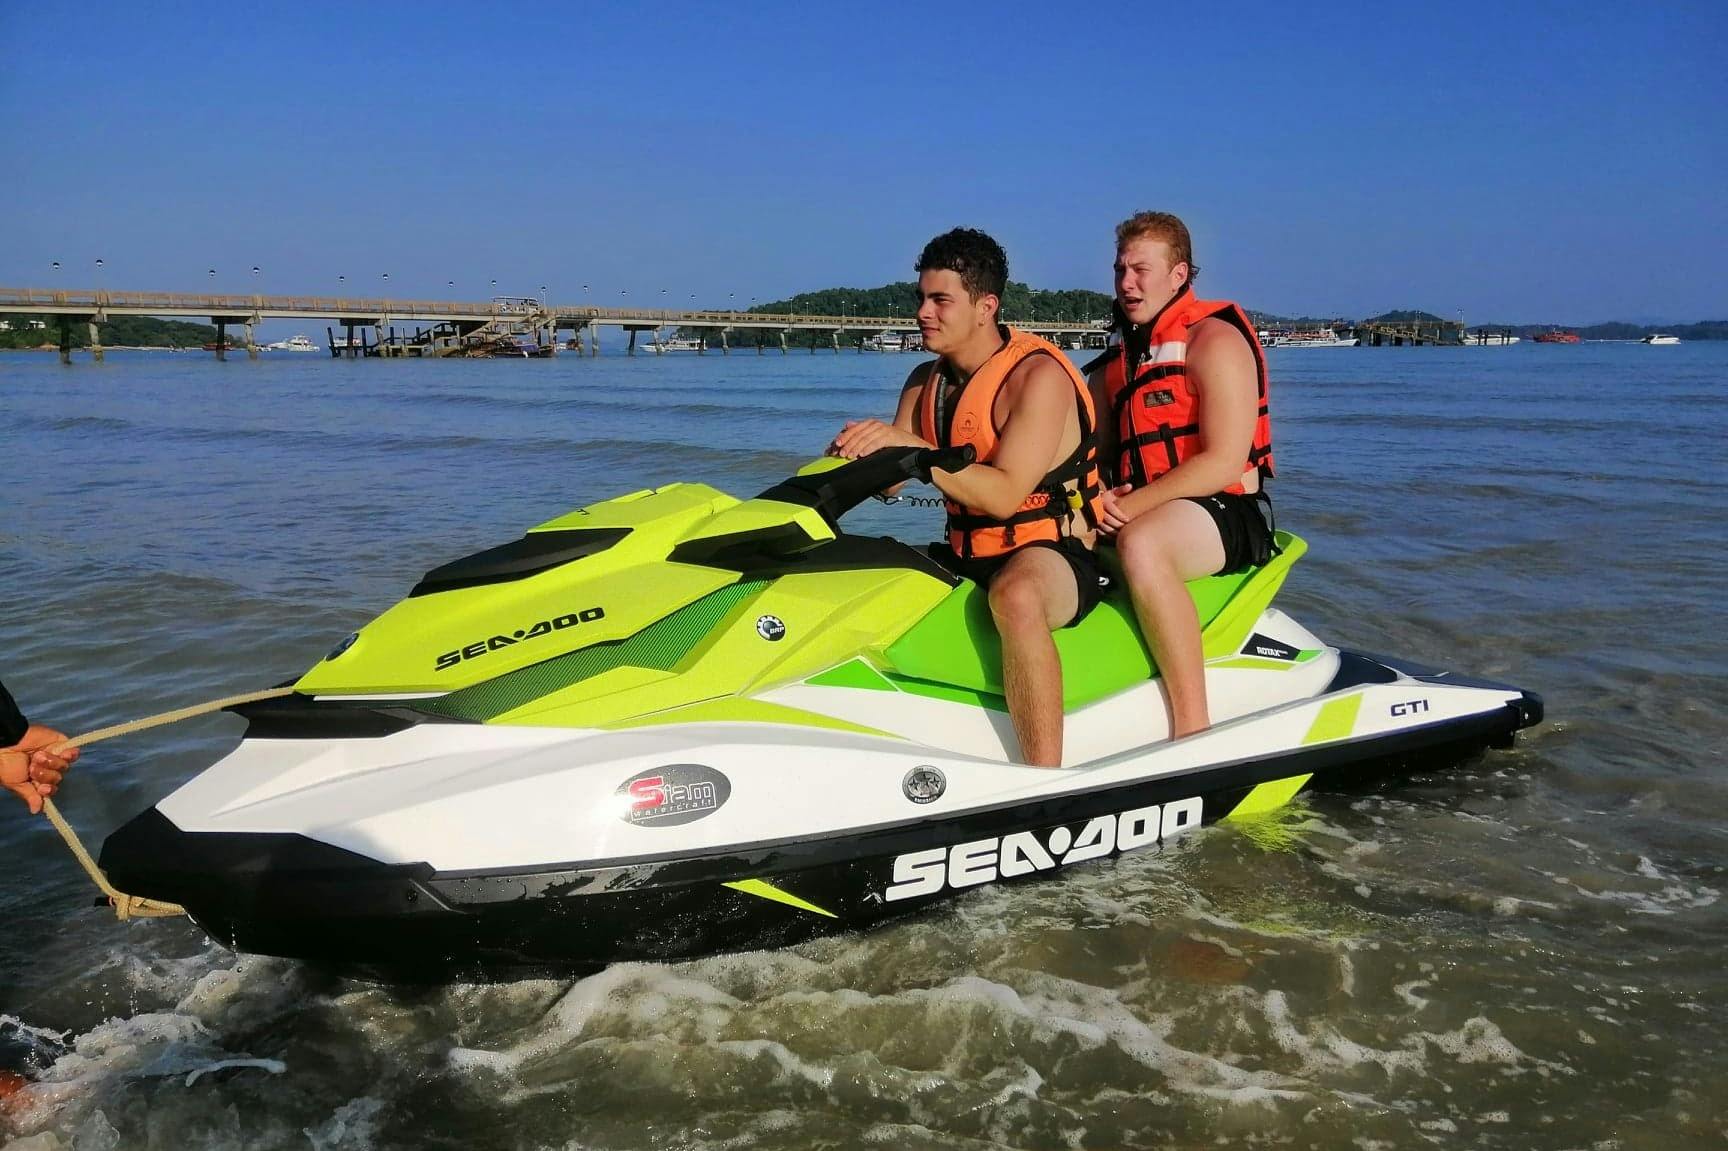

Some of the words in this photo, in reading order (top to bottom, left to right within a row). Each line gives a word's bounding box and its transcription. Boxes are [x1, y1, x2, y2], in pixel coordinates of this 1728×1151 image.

[1256, 646, 1281, 657] ROTAX
[1390, 699, 1429, 717] GTI
[628, 776, 716, 807] Siam
